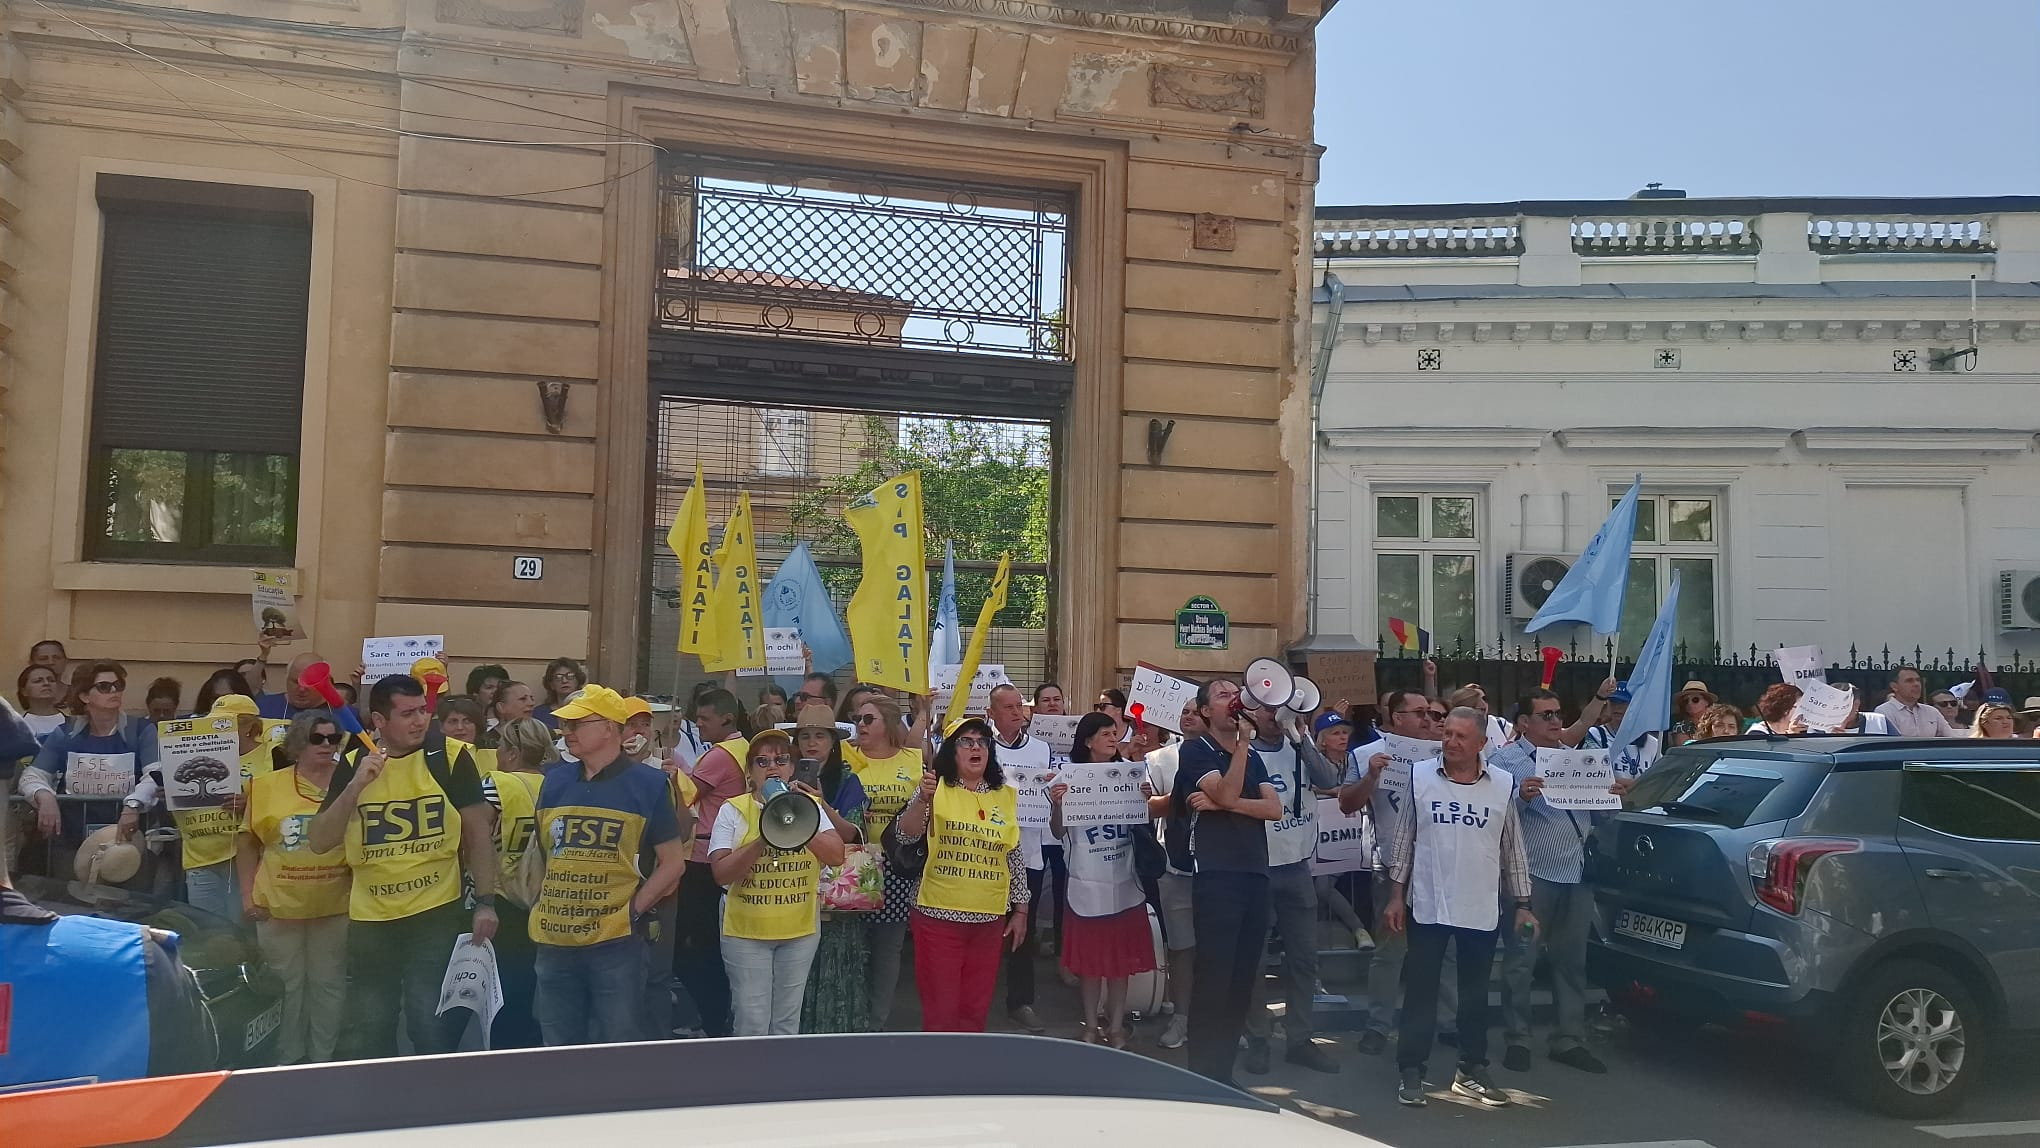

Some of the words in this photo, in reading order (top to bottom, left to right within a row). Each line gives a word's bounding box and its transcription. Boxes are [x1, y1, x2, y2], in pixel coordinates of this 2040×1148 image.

[520, 560, 537, 577] 29
[410, 649, 429, 657] ochi
[777, 643, 793, 651] ochi
[1808, 696, 1828, 709] Sare
[1035, 729, 1053, 737] Sare
[77, 757, 108, 771] FSE
[1391, 753, 1413, 765] Sare
[1544, 769, 1566, 778] Sare
[1586, 769, 1607, 778] ochi
[1018, 787, 1038, 796] ochi
[1070, 785, 1092, 794] Sare
[1113, 782, 1134, 793] ochi
[1573, 797, 1595, 805] daniel
[361, 797, 444, 844] FSE
[1067, 814, 1096, 822] DEMISIA
[1103, 812, 1125, 820] daniel
[1125, 811, 1146, 820] david!
[1433, 812, 1488, 829] ILFOV
[564, 818, 621, 849] FSE
[939, 834, 1006, 853] SINDICATELOR
[360, 847, 395, 865] Spiru
[398, 838, 445, 856] Haret
[937, 850, 954, 860] DIN
[380, 874, 433, 896] SECTOR
[432, 871, 440, 883] 5
[545, 869, 609, 885] Sindicatul
[542, 884, 610, 904] Salariaților
[1620, 911, 1630, 929] B
